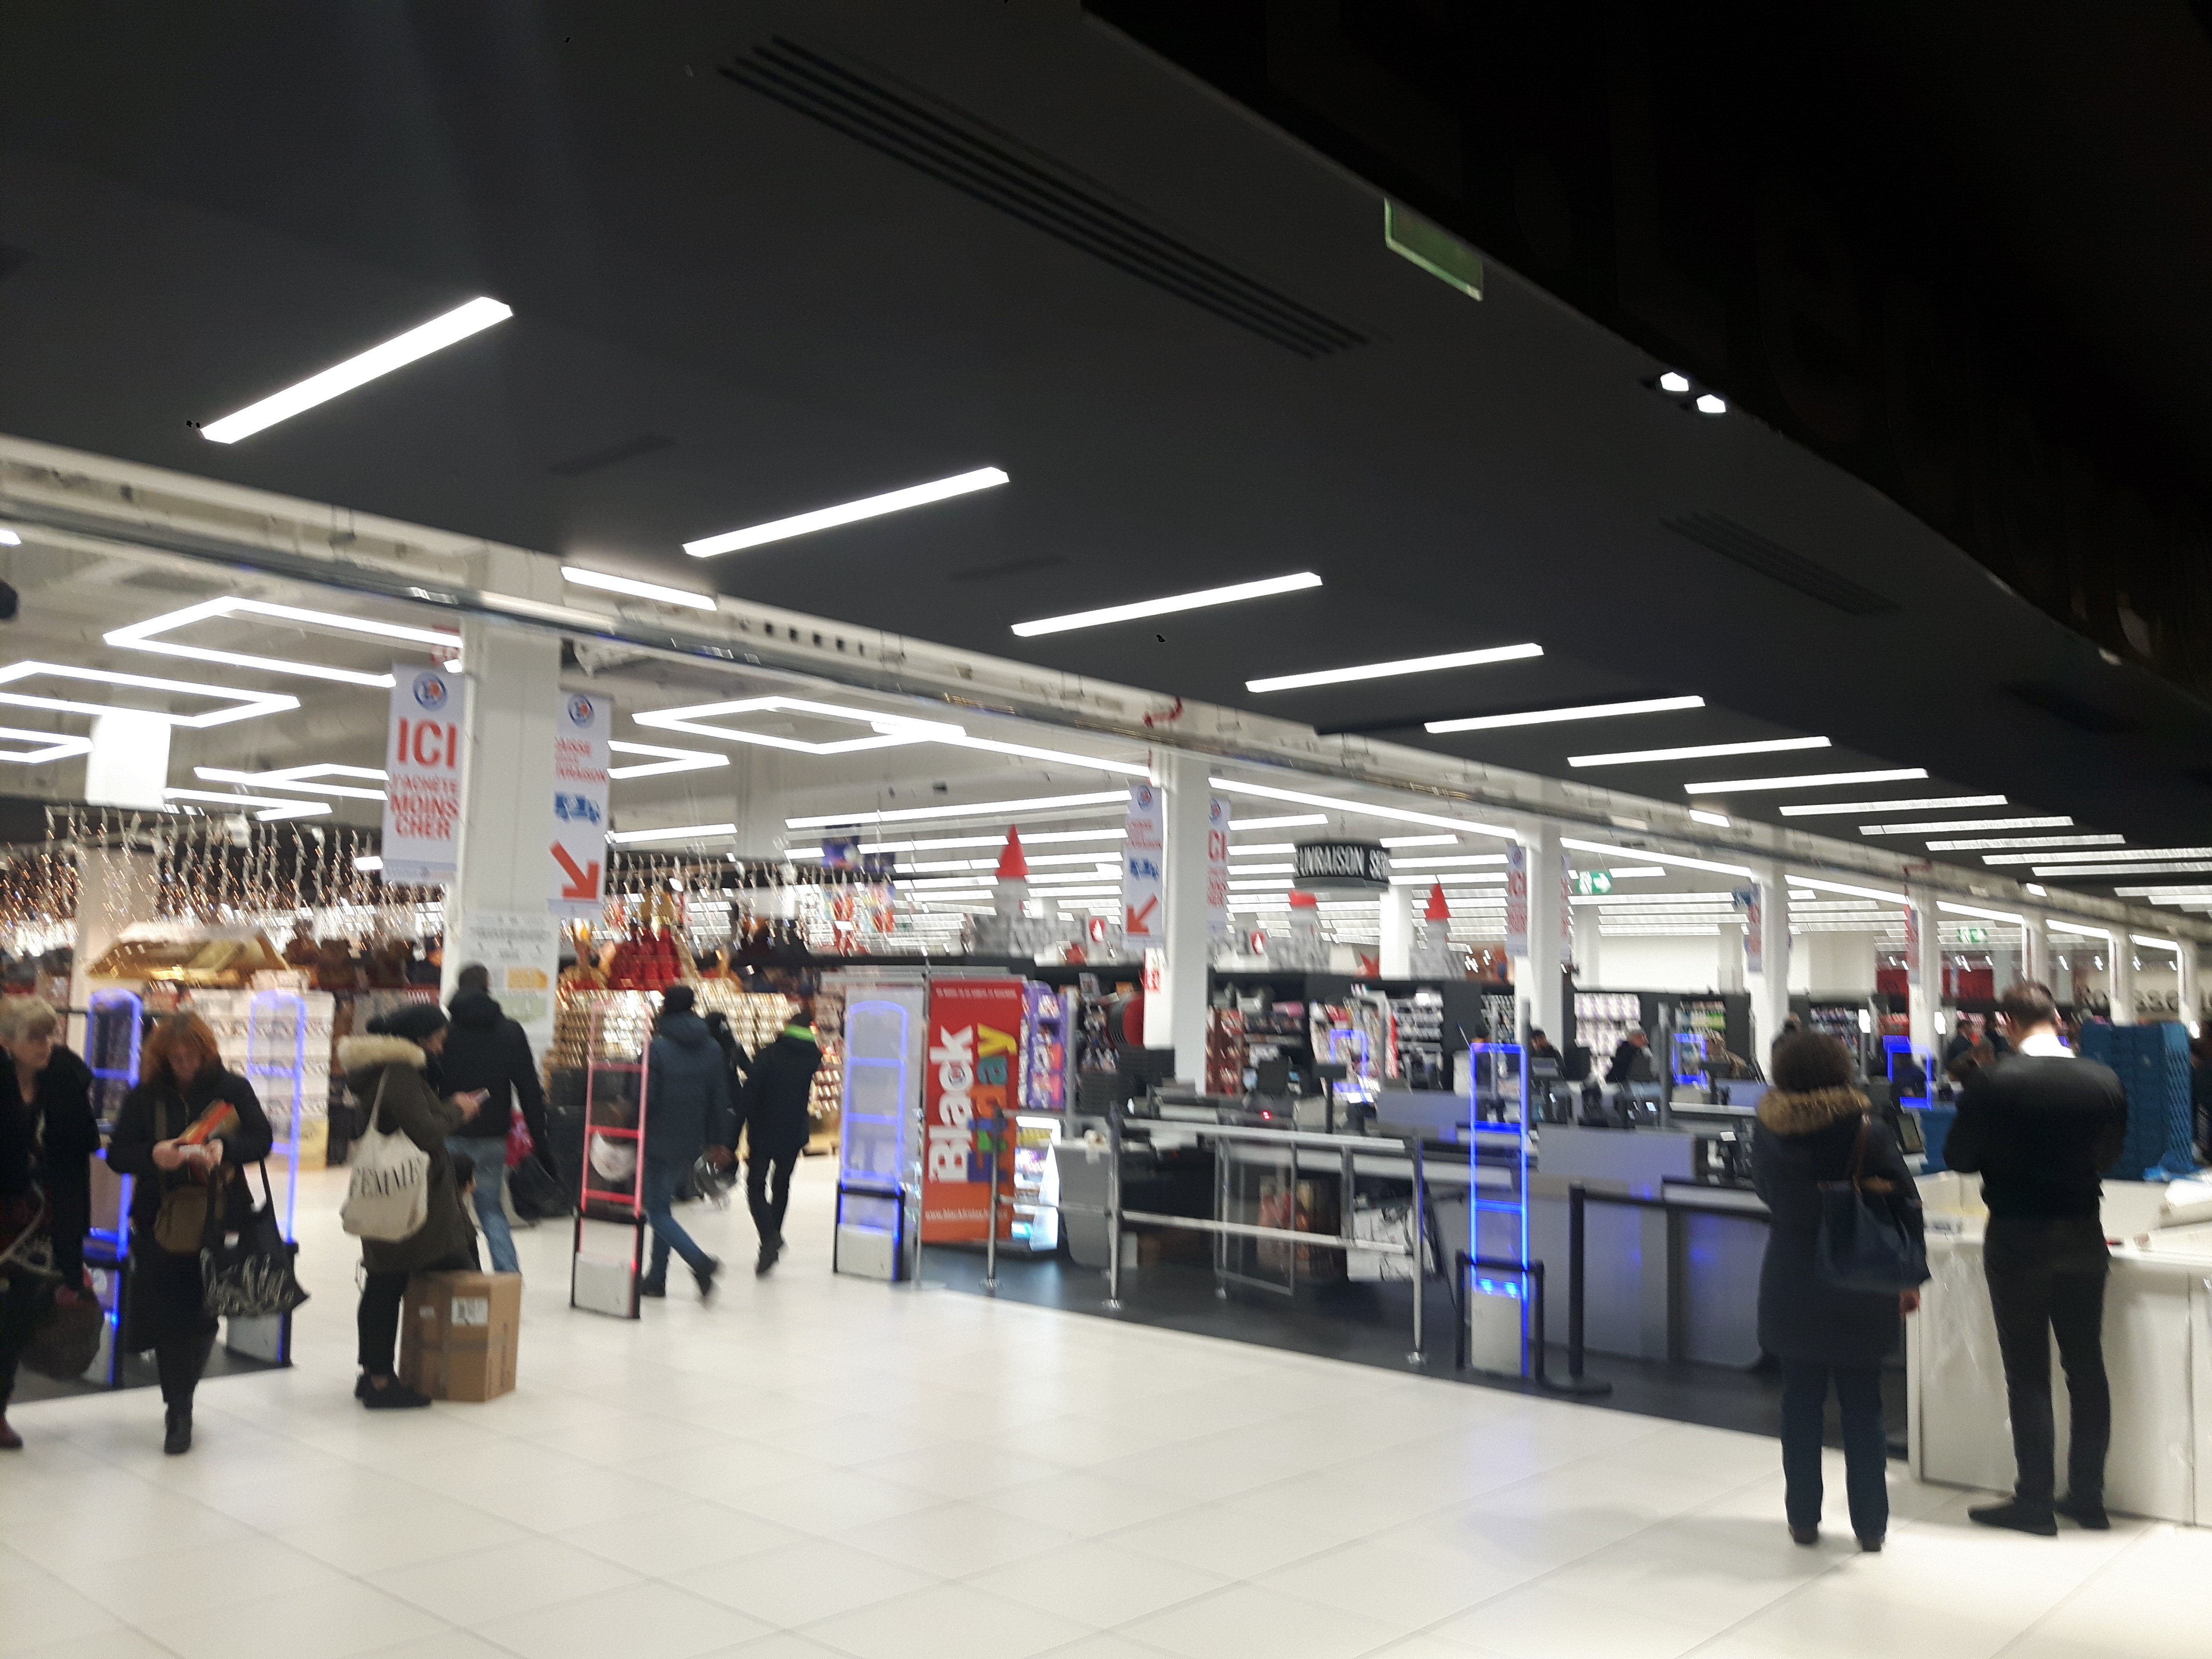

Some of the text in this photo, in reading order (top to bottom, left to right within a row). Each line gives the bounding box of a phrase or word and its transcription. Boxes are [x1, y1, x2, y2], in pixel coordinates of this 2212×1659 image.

[397, 717, 457, 769] ICI
[390, 793, 459, 819] MOINS
[395, 815, 451, 840] CHER
[928, 1024, 974, 1184] Black
[966, 1022, 1018, 1183] Friday
